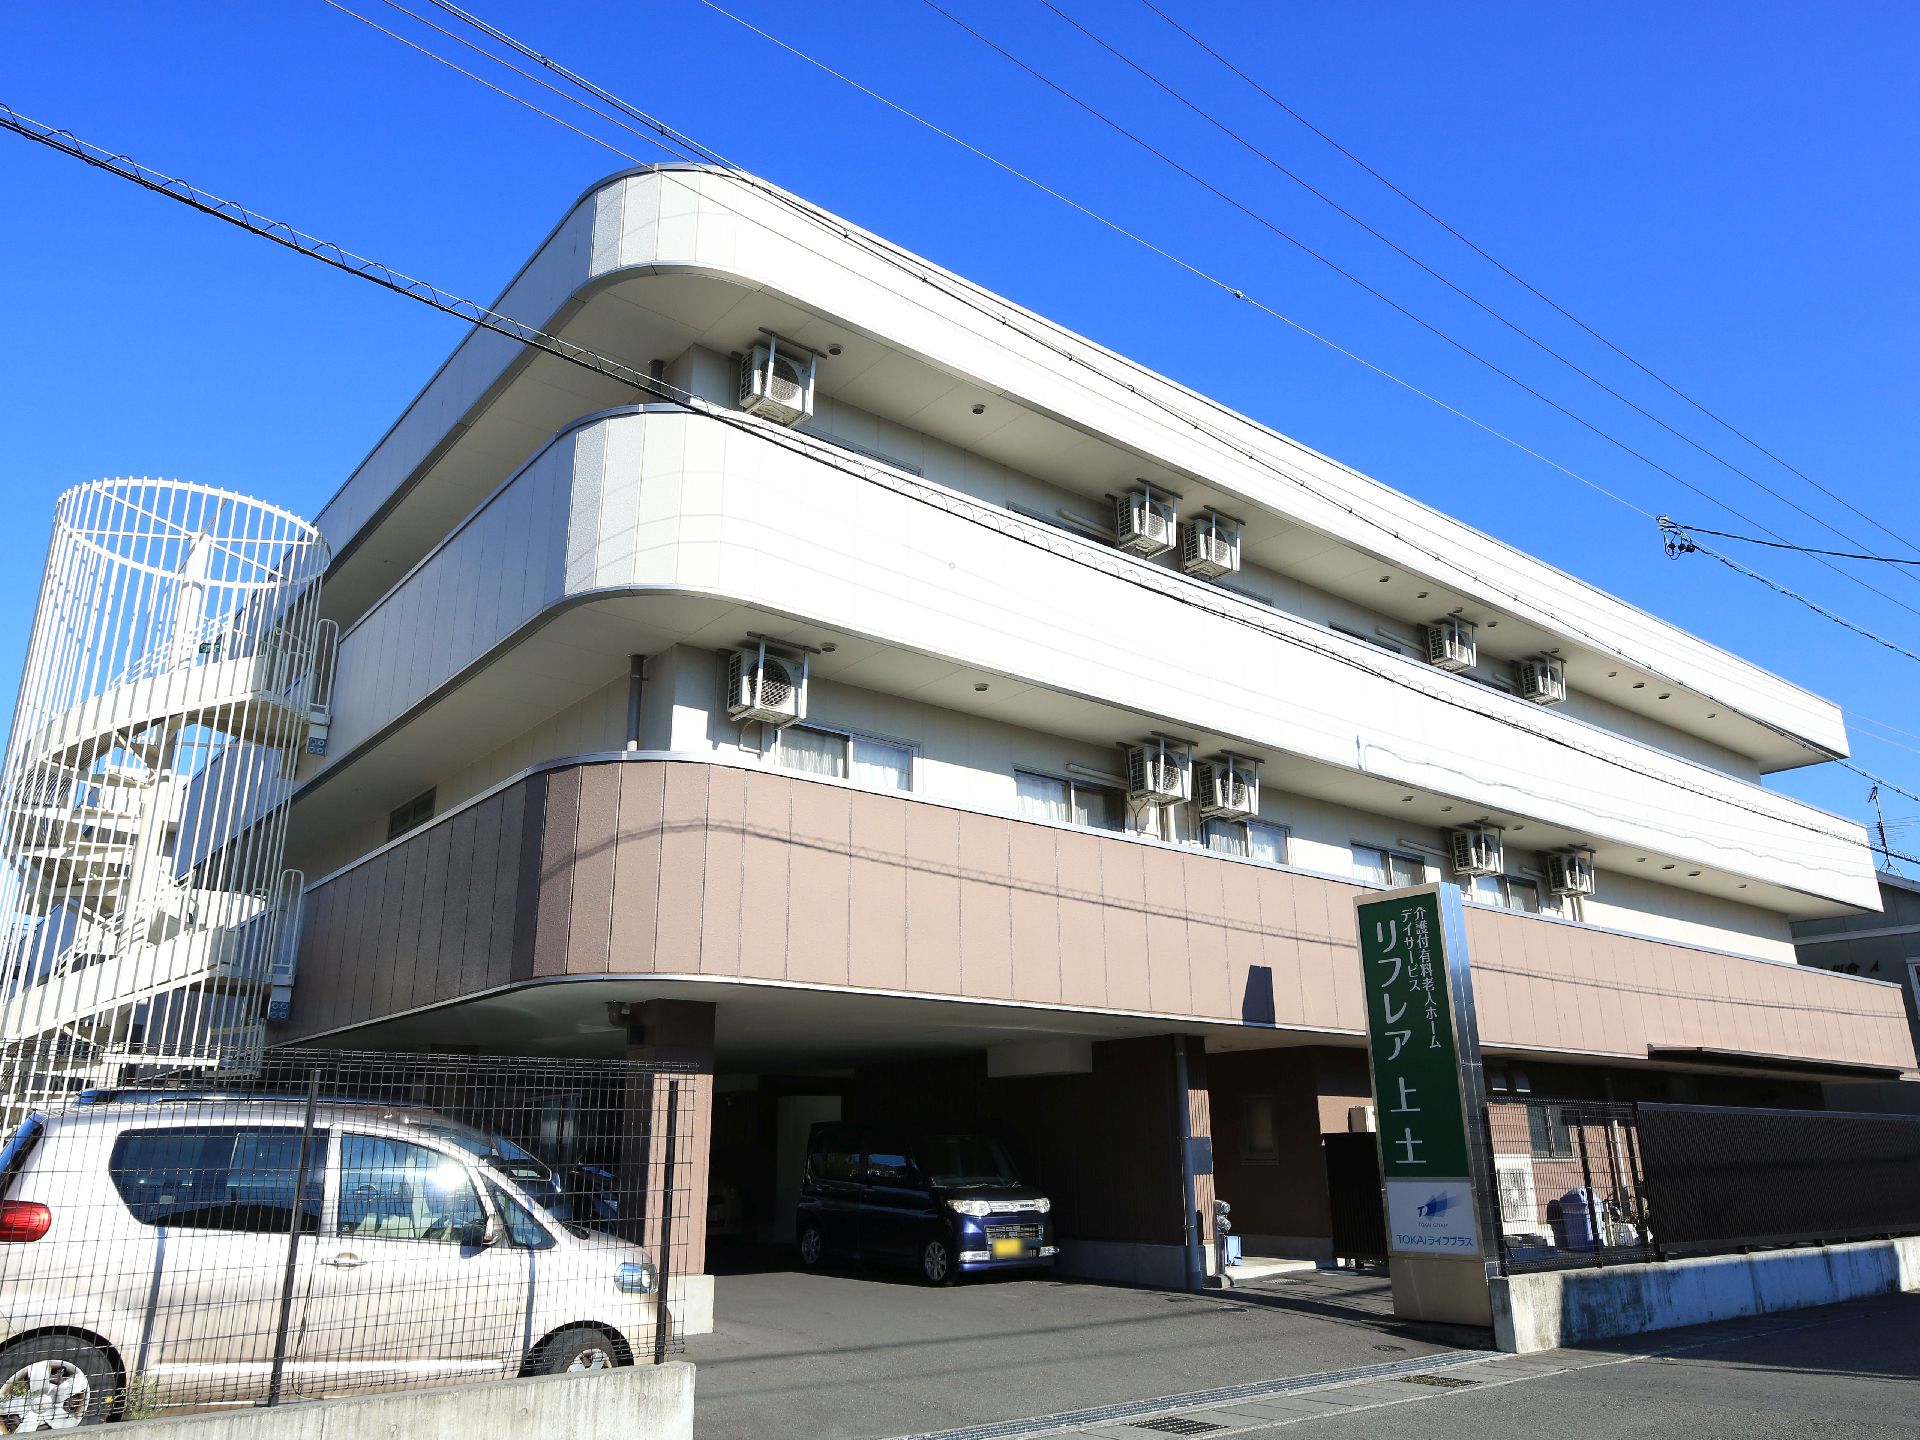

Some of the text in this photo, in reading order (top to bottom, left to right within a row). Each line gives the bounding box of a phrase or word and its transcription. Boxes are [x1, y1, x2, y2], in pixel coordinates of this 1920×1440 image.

[1401, 908, 1421, 992] デイサービス
[1414, 906, 1441, 1049] 介護付有料老人ホーム
